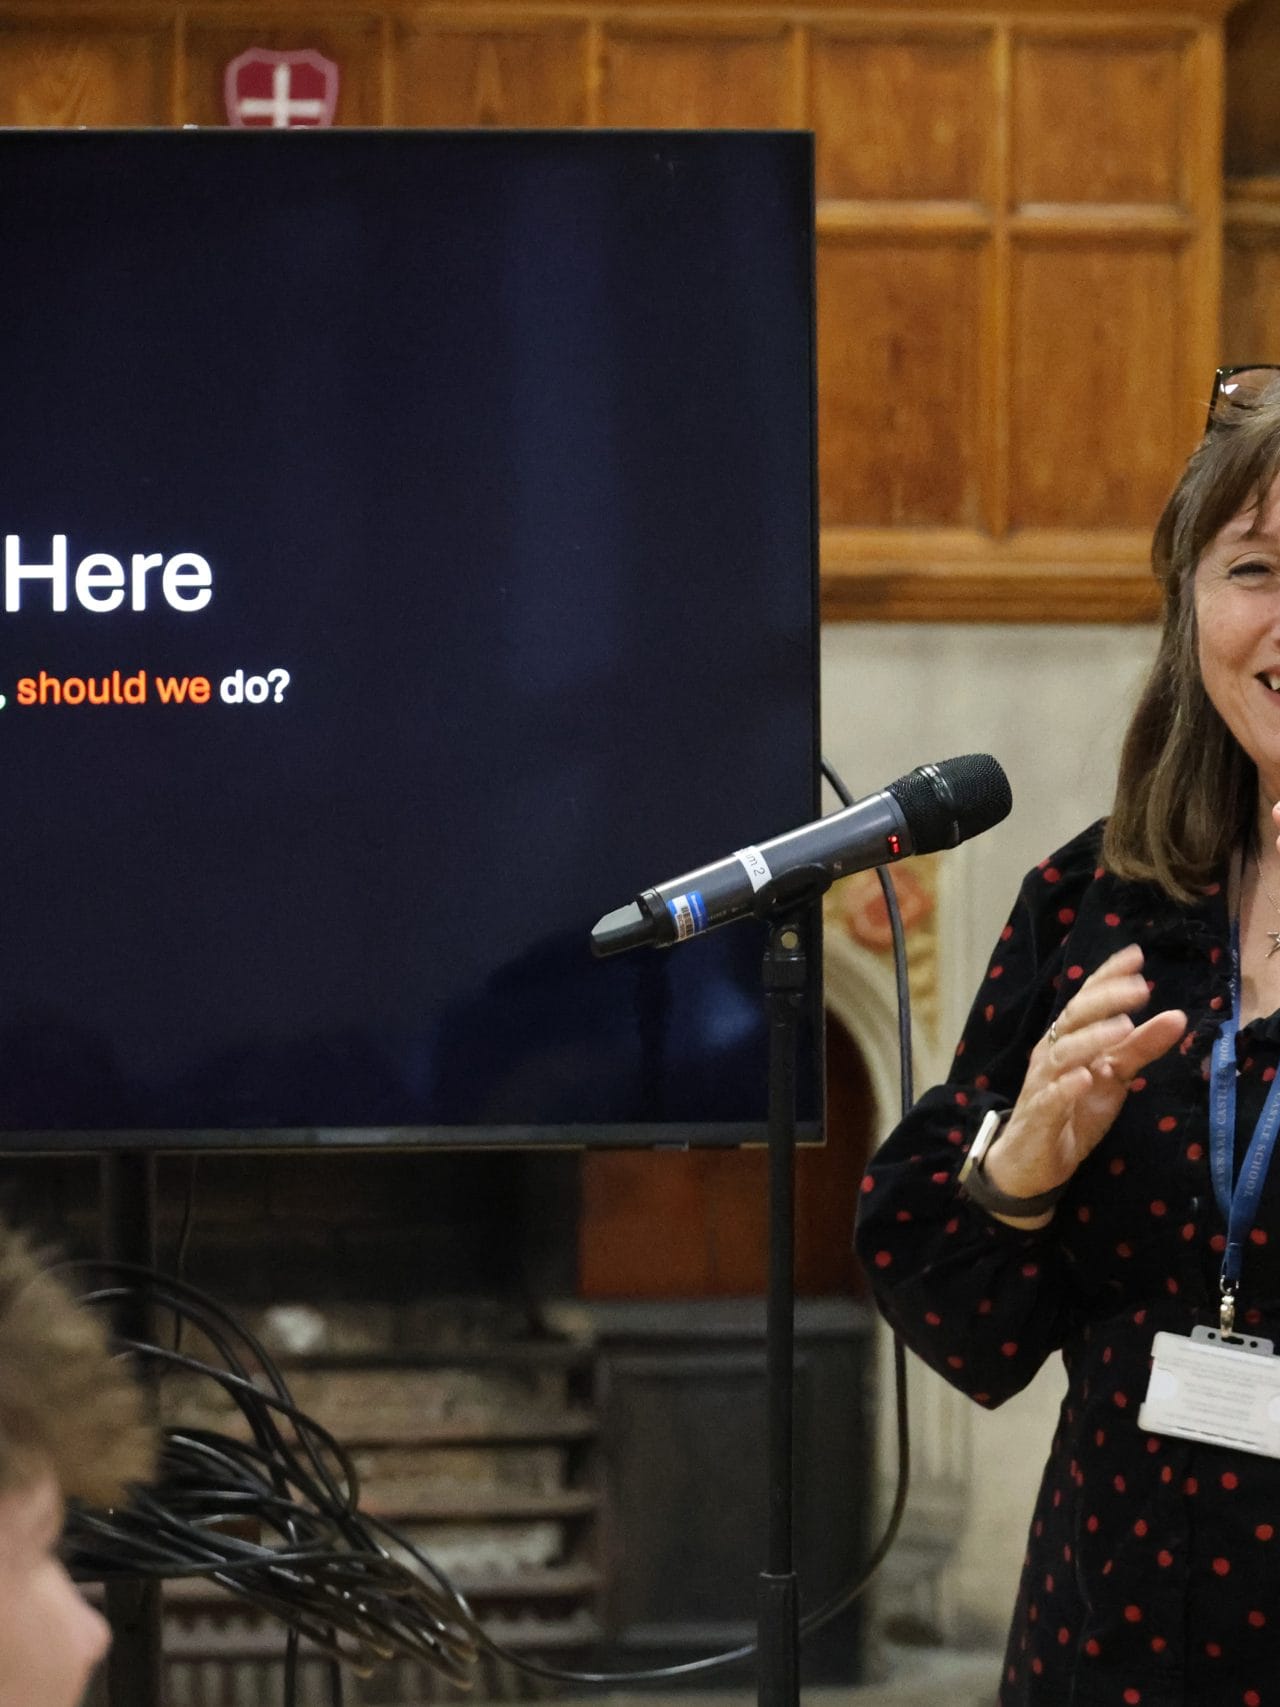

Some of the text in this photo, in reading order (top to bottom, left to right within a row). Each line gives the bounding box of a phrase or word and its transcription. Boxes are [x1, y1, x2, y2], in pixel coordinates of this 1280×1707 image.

[5, 534, 213, 613] Here
[17, 668, 290, 705] should we do?
[1241, 1144, 1266, 1198] SCHOOL
